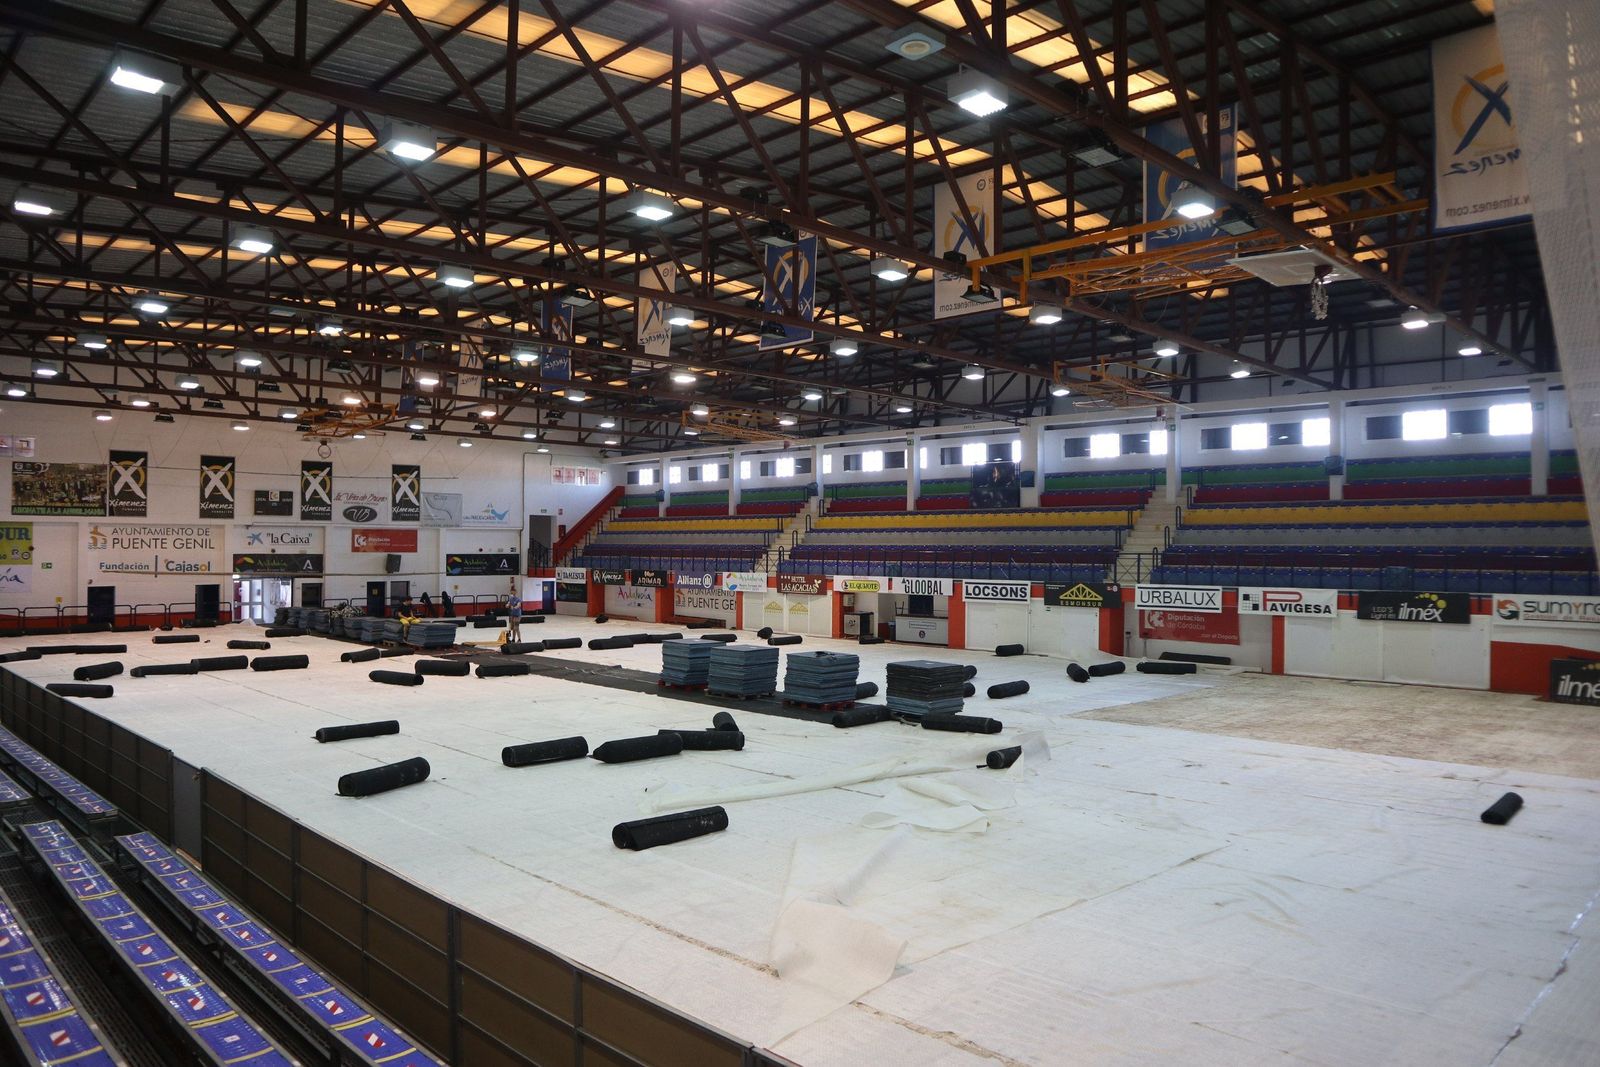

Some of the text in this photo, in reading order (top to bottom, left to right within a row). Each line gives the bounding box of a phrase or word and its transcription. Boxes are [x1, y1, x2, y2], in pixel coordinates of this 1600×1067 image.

[111, 527, 210, 536] AYUNTAMIENTO DE
[112, 537, 215, 550] PUENTE GENIL
[100, 559, 211, 572] Fundación Cajasol
[676, 575, 702, 585] Allianz
[904, 579, 944, 596] GLOOBAL
[965, 584, 1028, 598] LOCSONS
[688, 597, 719, 609] PUENTE
[1140, 590, 1217, 606] URBALUX
[1263, 591, 1332, 614] PAVIGESA
[1167, 613, 1205, 622] Diputación
[1398, 602, 1443, 622] ilméx
